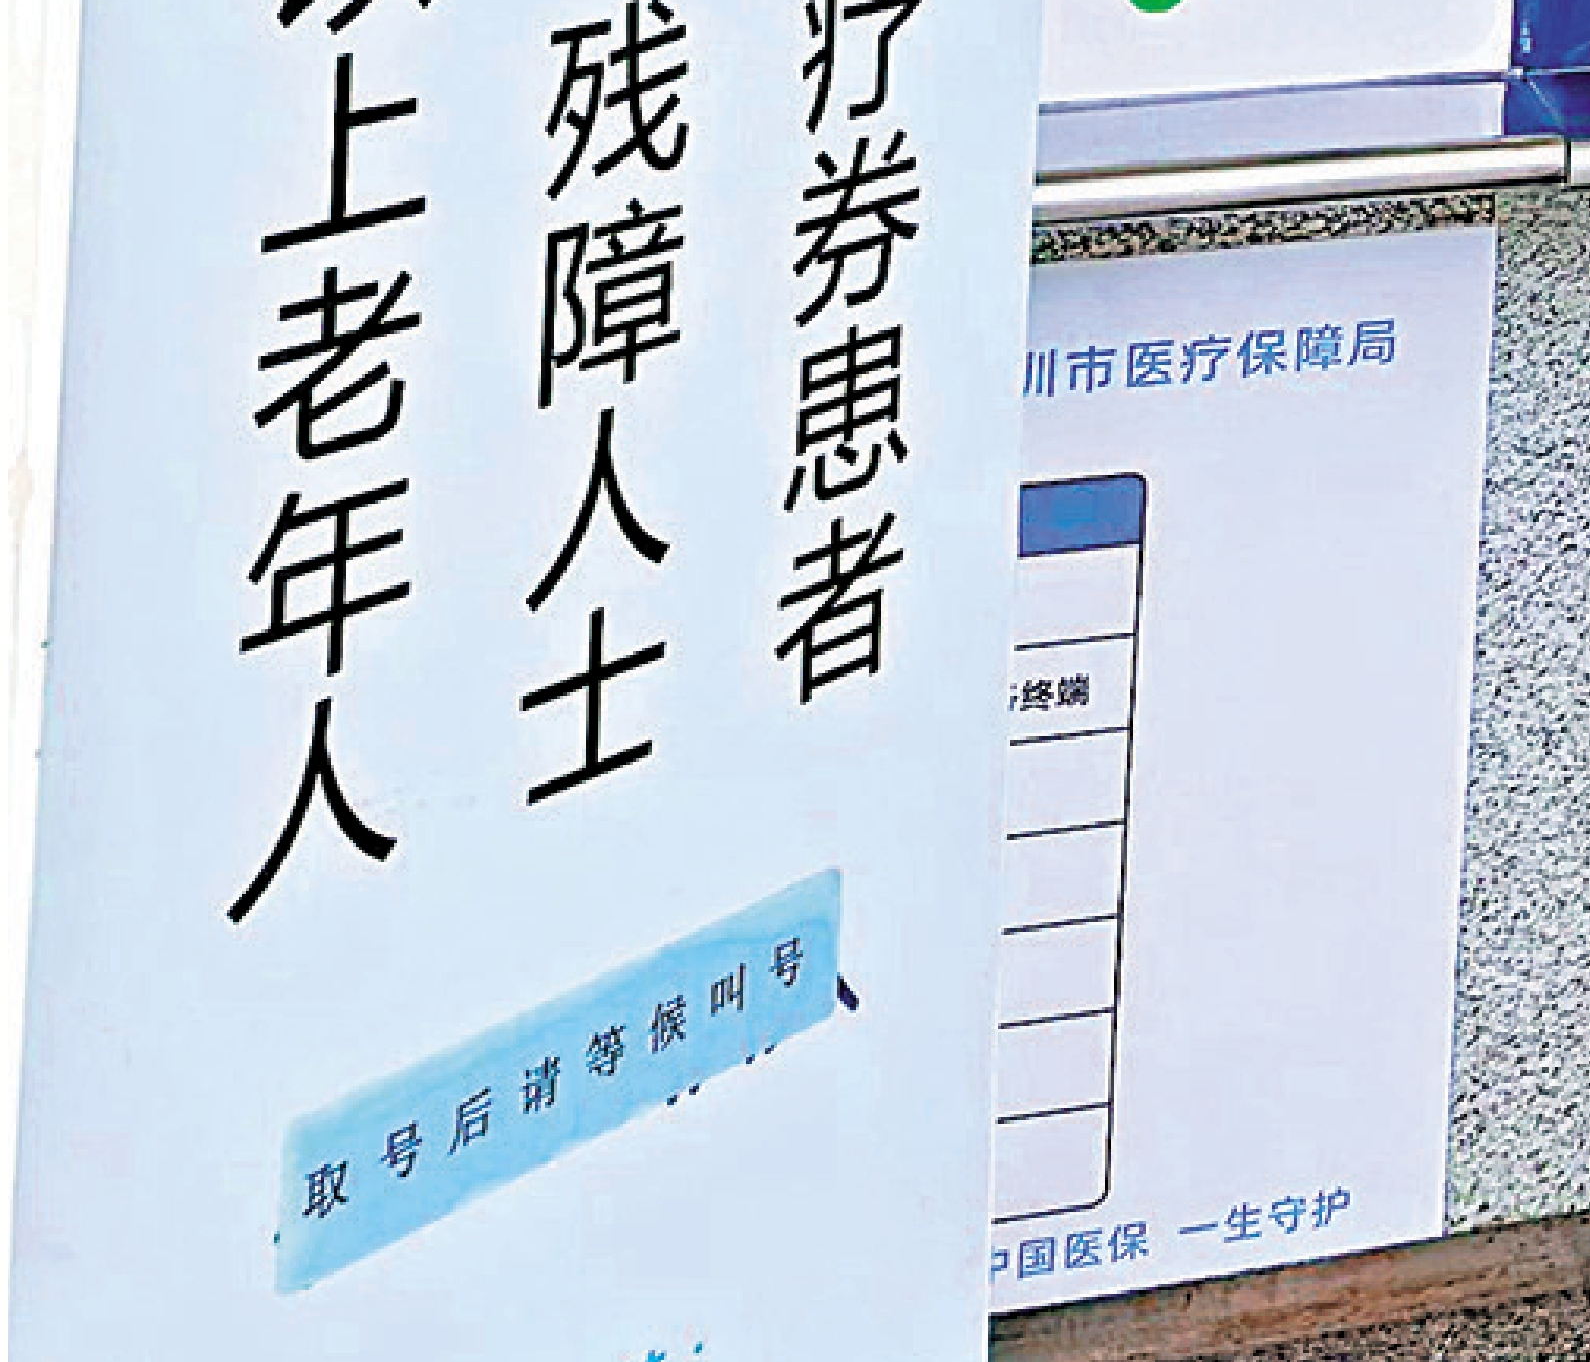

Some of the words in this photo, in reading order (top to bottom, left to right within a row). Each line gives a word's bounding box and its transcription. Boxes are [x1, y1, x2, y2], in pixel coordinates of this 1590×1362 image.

[1008, 672, 1090, 712] 终端
[302, 937, 803, 1219] 取号后请等候叫号
[1177, 1184, 1352, 1244] 一生守护
